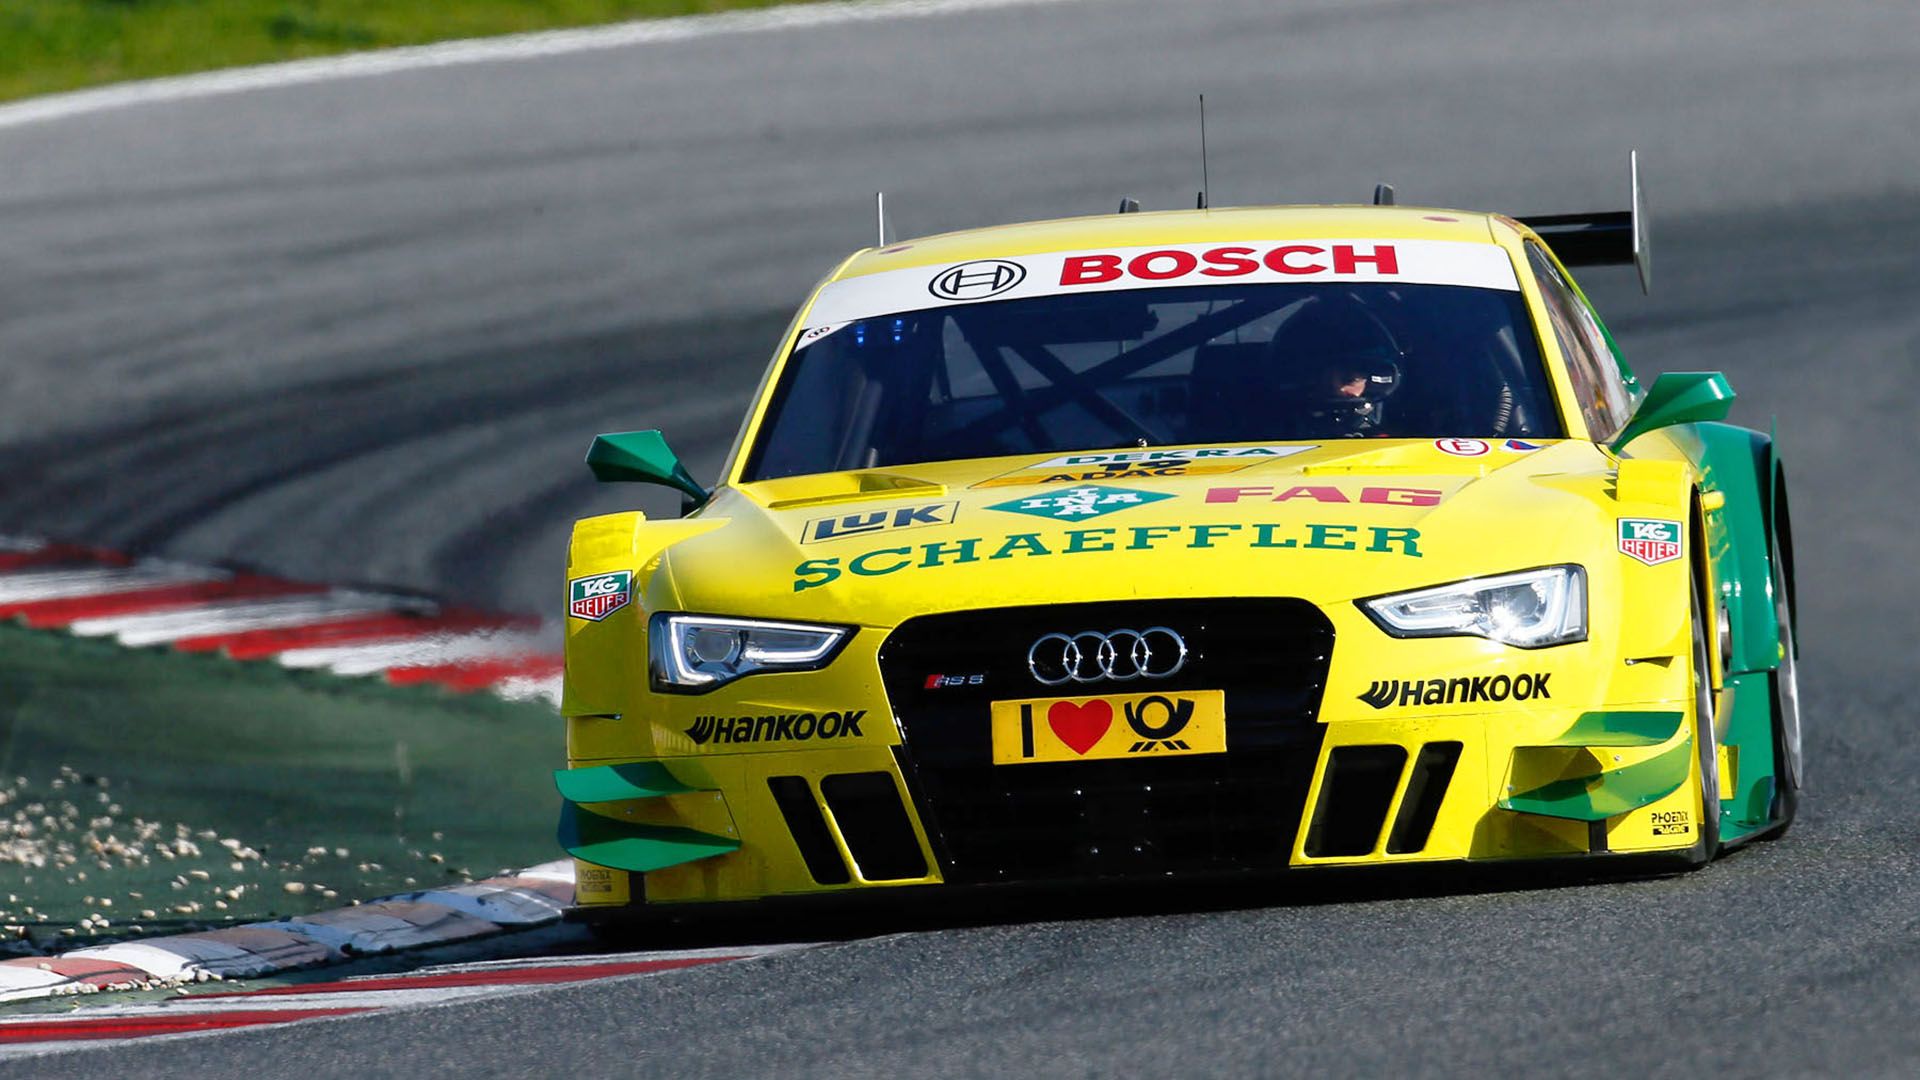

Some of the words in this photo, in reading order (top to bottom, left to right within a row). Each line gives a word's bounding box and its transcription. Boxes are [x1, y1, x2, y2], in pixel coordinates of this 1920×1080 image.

[1059, 245, 1399, 286] BOSCH
[1066, 448, 1279, 465] DEKRA
[1040, 468, 1187, 483] ADAC
[1205, 486, 1442, 507] FAG
[1630, 523, 1671, 540] TAG
[793, 523, 1424, 592] SCHAEFFLER
[1624, 541, 1677, 561] HEUER
[581, 576, 620, 597] TAG
[575, 594, 625, 616] HEUER
[1020, 703, 1035, 758] I
